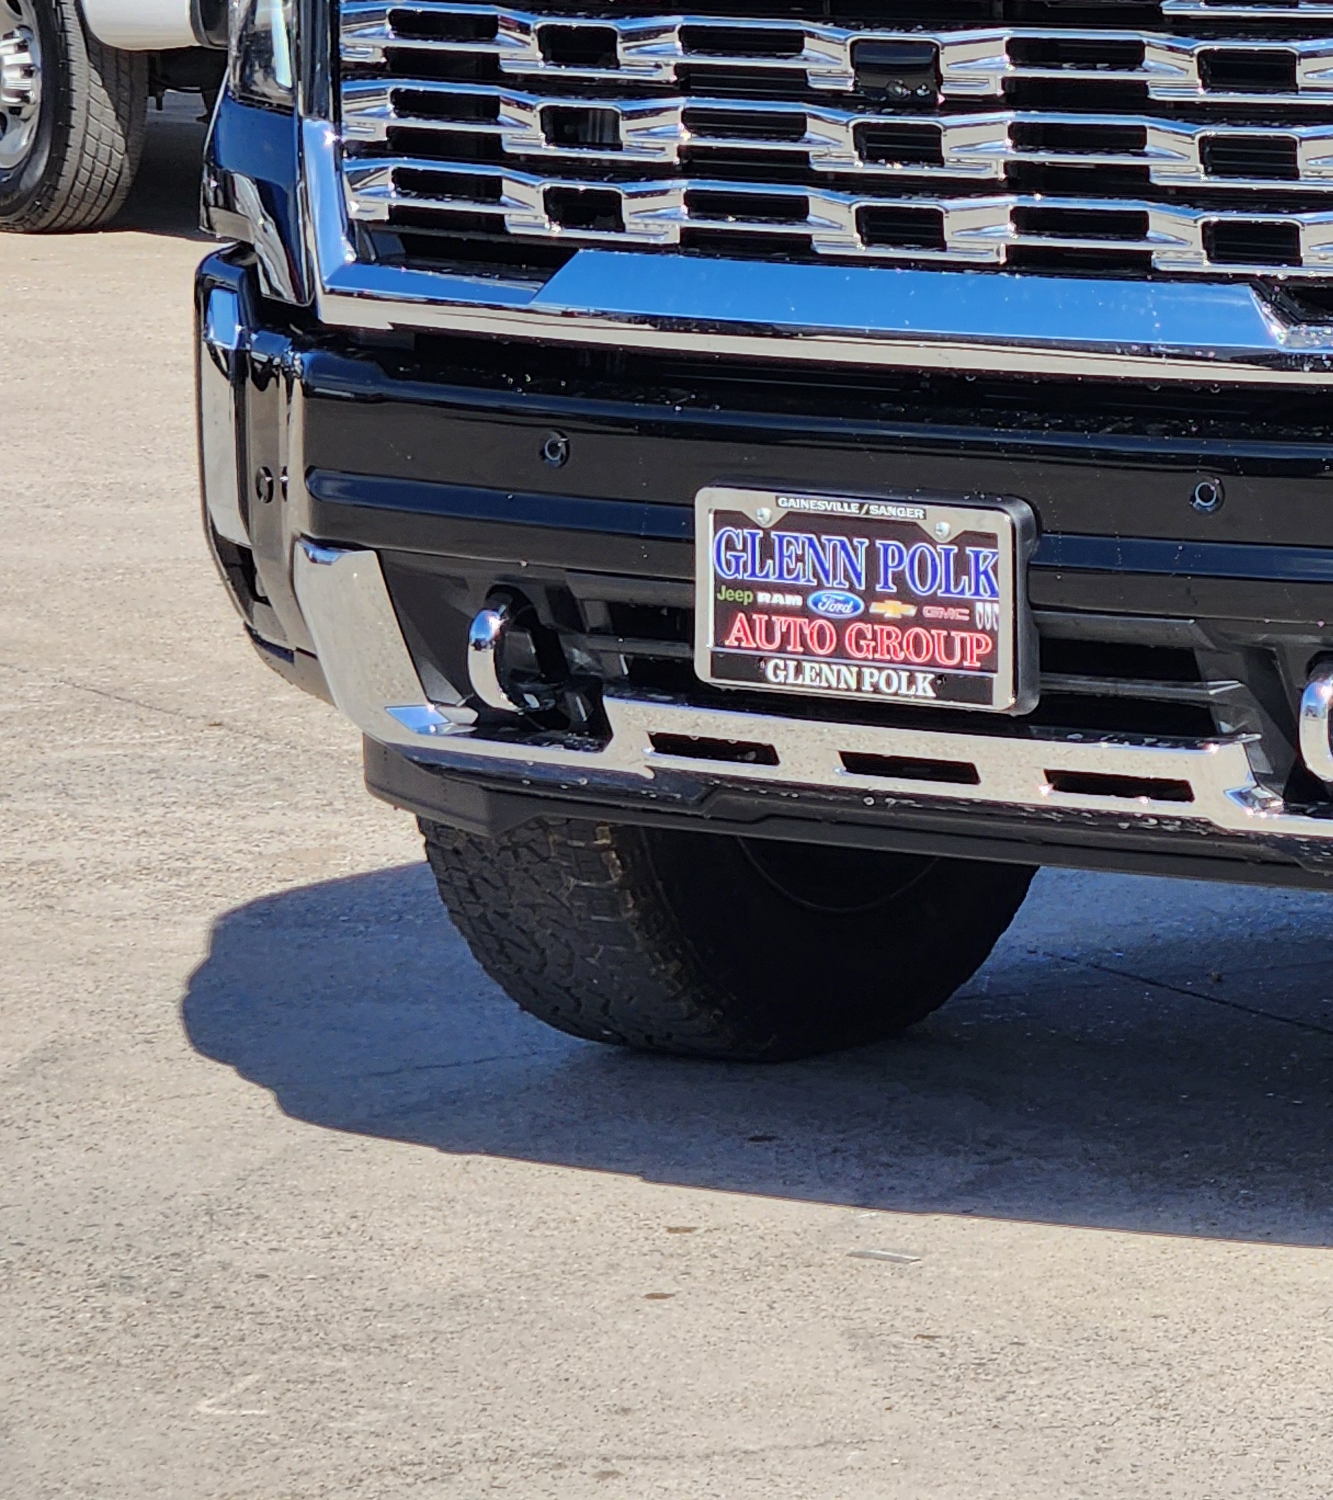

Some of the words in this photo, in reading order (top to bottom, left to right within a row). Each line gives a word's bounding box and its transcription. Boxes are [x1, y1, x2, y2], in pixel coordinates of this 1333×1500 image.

[777, 497, 860, 514] GAINESVILLE
[868, 504, 926, 519] SANGER
[713, 526, 869, 590] GLENN
[875, 538, 1000, 600] POLK
[717, 585, 753, 605] Jeep
[757, 591, 803, 606] RAM
[922, 606, 970, 621] GMC
[725, 612, 837, 655] AUTO
[845, 622, 993, 667] GROUP
[765, 658, 859, 691] GLENN
[861, 666, 937, 698] POLK
